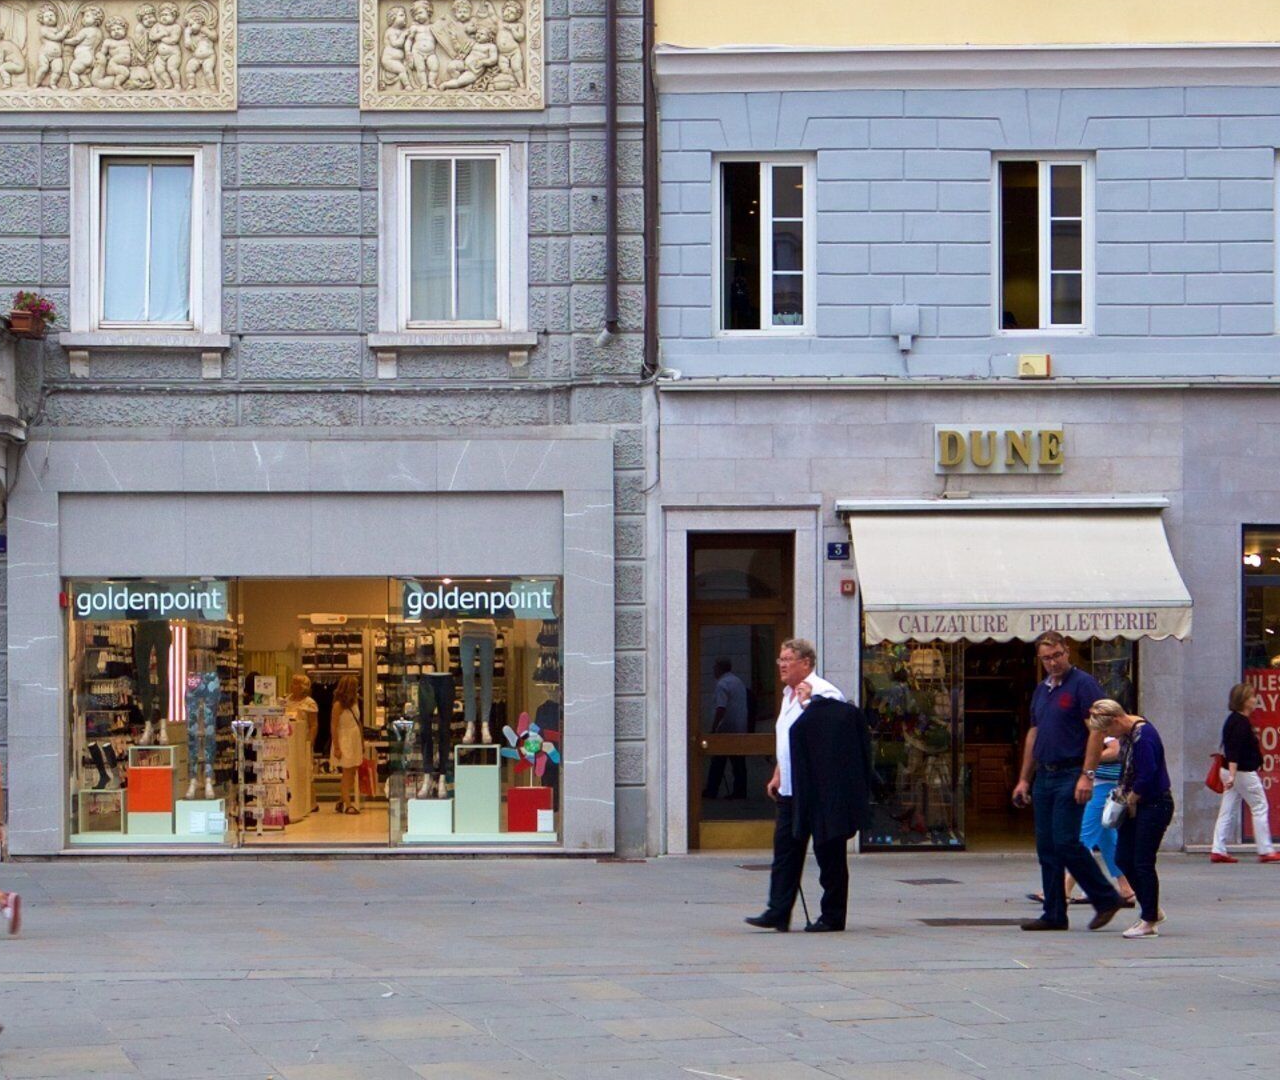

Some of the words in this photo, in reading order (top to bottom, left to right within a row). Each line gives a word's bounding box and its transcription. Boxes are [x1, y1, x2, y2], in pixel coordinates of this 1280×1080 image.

[938, 430, 1064, 467] DUNE
[834, 544, 842, 555] 3
[76, 586, 221, 616] goldenpoint
[407, 585, 552, 615] goldenpoint
[898, 614, 1008, 634] CALZATURE
[1029, 612, 1158, 632] PELLETTERIE
